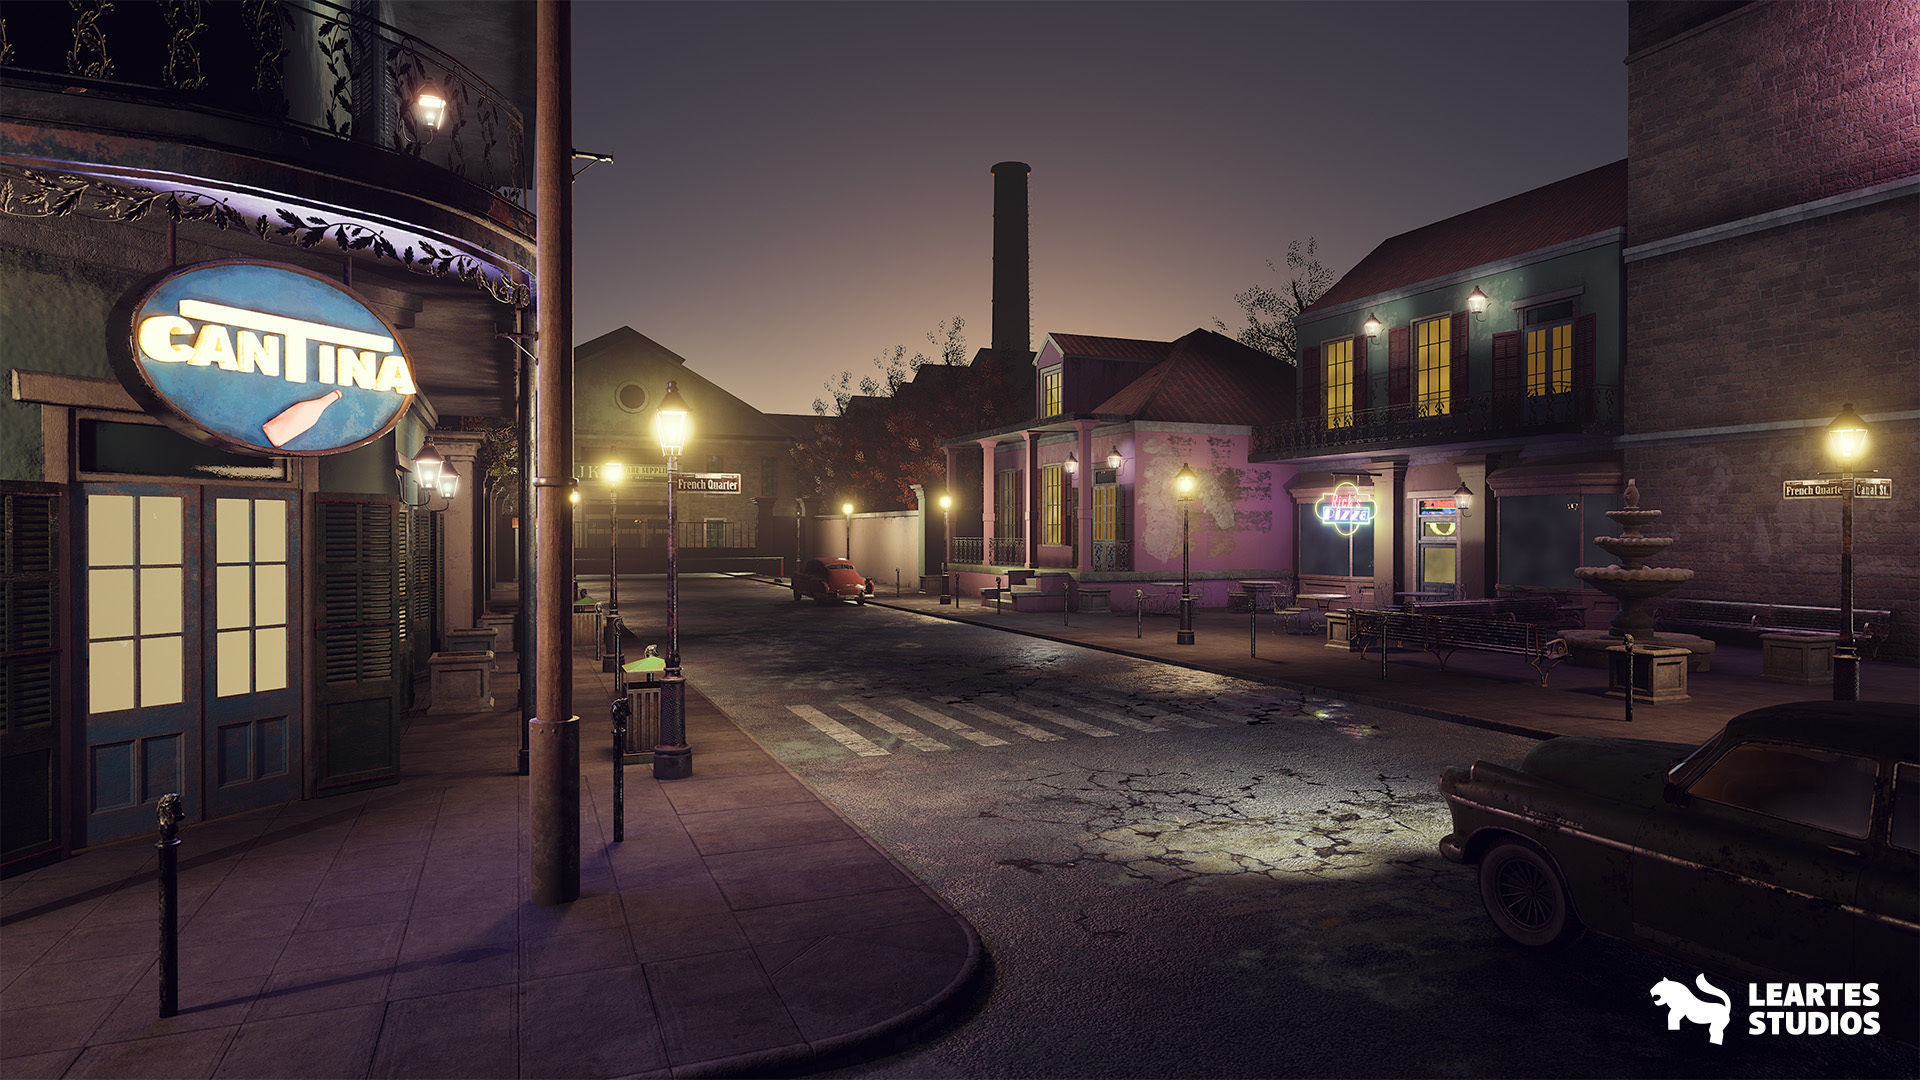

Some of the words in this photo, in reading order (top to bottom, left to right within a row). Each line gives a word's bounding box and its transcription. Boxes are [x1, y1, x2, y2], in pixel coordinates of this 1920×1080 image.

[138, 300, 416, 395] CANTINA
[678, 479, 706, 490] French
[707, 479, 738, 490] Quarter
[1786, 486, 1814, 496] French
[1815, 485, 1843, 495] Quarte
[1857, 484, 1878, 495] Canal
[1879, 484, 1889, 495] St.
[1332, 494, 1361, 508] Rick's
[1325, 507, 1367, 521] Pizza
